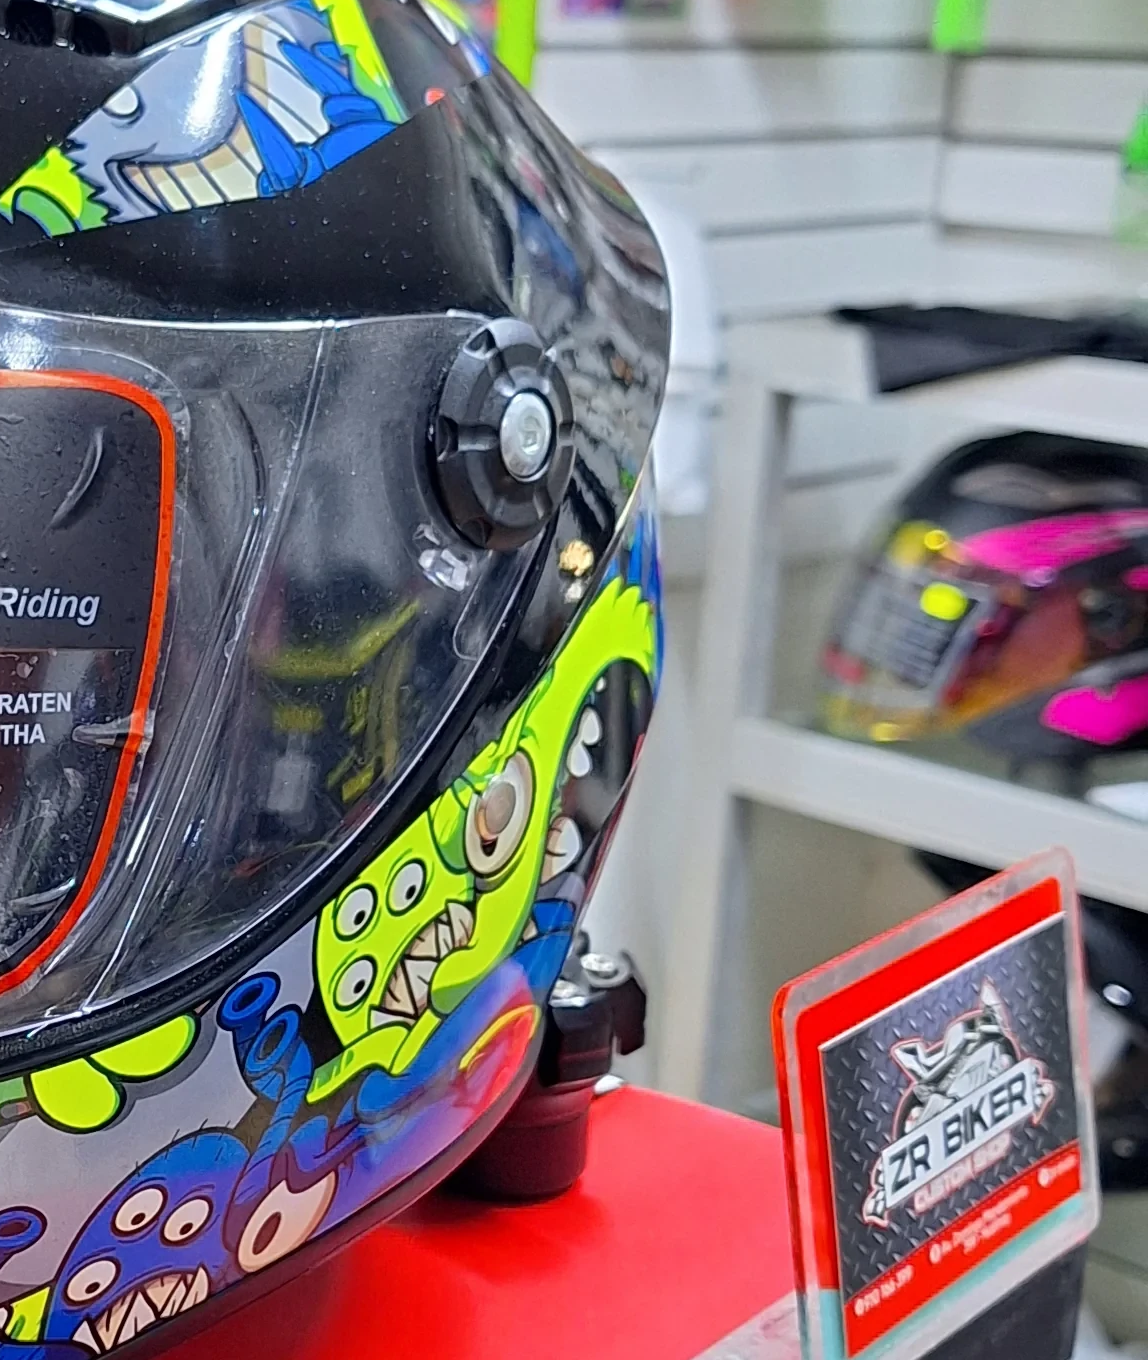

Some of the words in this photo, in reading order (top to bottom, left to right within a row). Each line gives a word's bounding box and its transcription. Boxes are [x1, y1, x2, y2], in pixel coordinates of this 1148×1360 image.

[0, 724, 46, 746] THA
[888, 1133, 932, 1196] ZR
[943, 1071, 1028, 1158] BIKER
